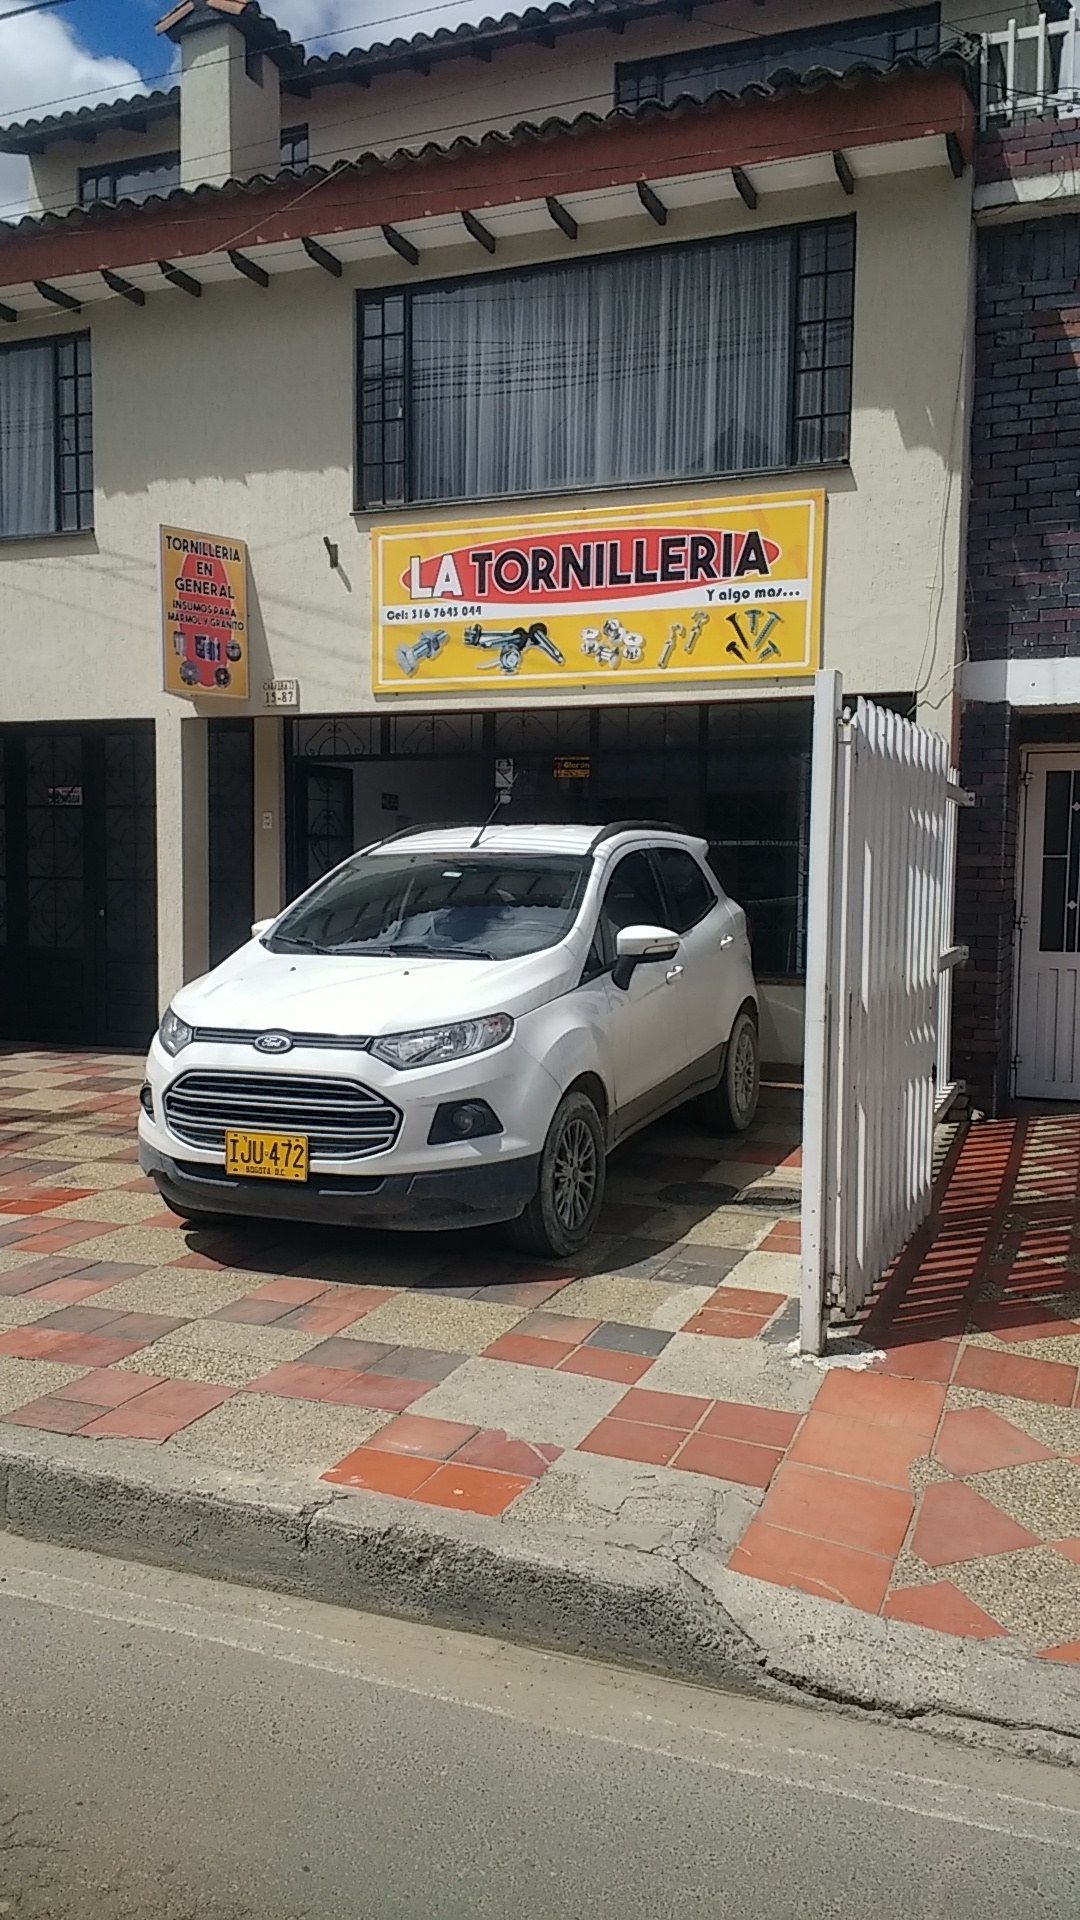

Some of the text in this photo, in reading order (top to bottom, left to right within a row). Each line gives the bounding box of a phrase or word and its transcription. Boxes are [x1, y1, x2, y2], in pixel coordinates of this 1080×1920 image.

[166, 535, 241, 562] TORNILLERIA
[196, 561, 213, 577] EN
[410, 530, 771, 600] LA TORNILLERIA
[174, 577, 235, 600] GENERAL
[706, 589, 716, 602] Y
[718, 588, 751, 603] algo
[172, 600, 237, 618] INSUMOS PARA
[386, 610, 409, 621] Cel:
[411, 609, 431, 619] 316
[461, 605, 482, 617] 044
[167, 611, 245, 631] MARMOL Y GRANITO
[265, 691, 294, 704] 15-87
[261, 1037, 283, 1047] Ford
[245, 1165, 271, 1175] BOGOTA
